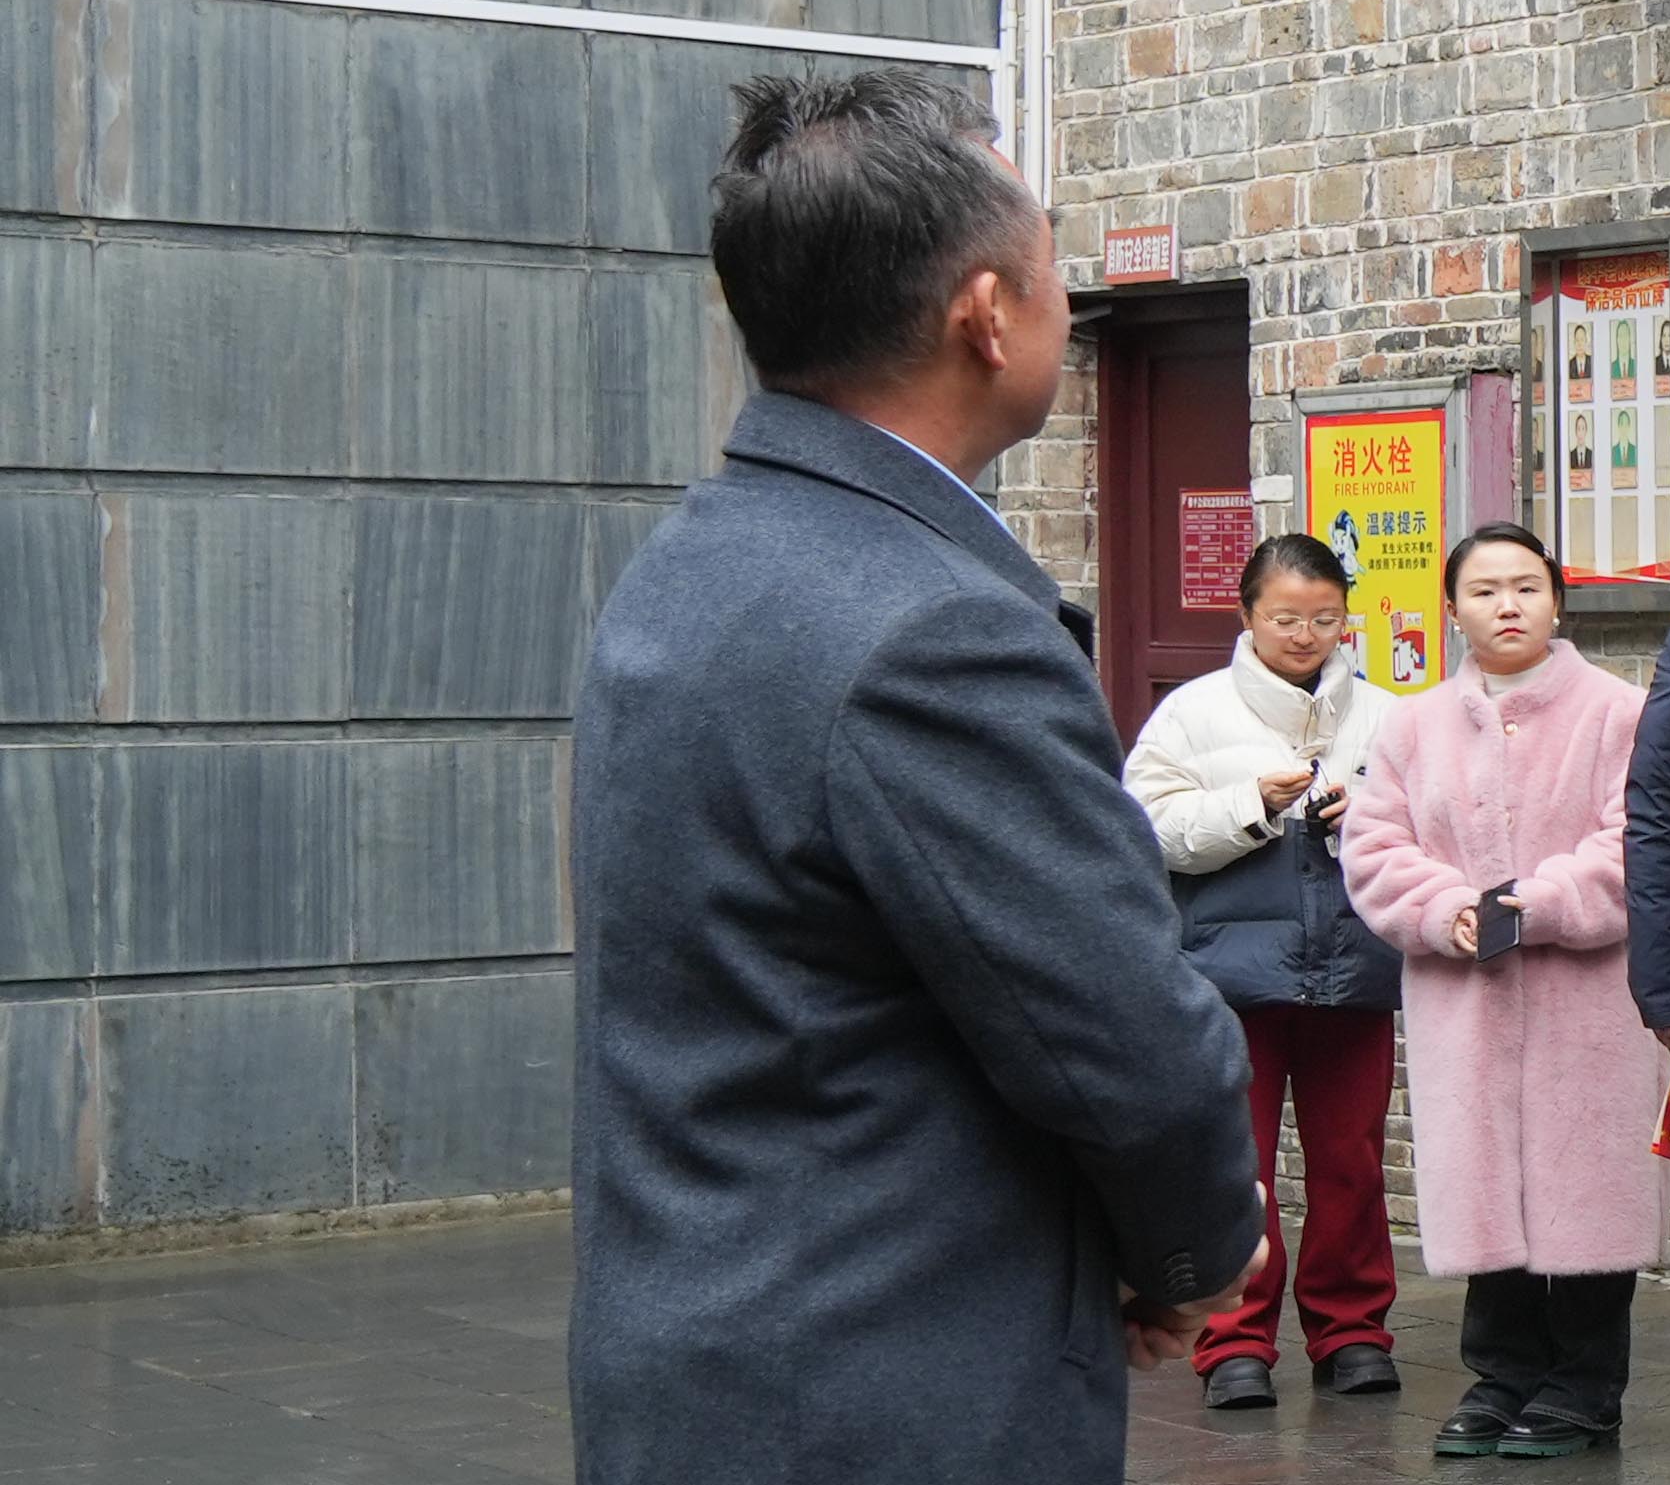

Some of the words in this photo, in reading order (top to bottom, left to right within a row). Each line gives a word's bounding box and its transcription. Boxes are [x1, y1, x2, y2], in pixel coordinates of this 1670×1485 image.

[1106, 234, 1171, 275] 消防安全控制室
[1584, 284, 1666, 312] 保洁员岗位牌
[1333, 436, 1413, 478] 消火栓
[1334, 482, 1359, 497] FIRE
[1362, 480, 1416, 495] HYDRANT
[1367, 511, 1426, 535] 温馨提示
